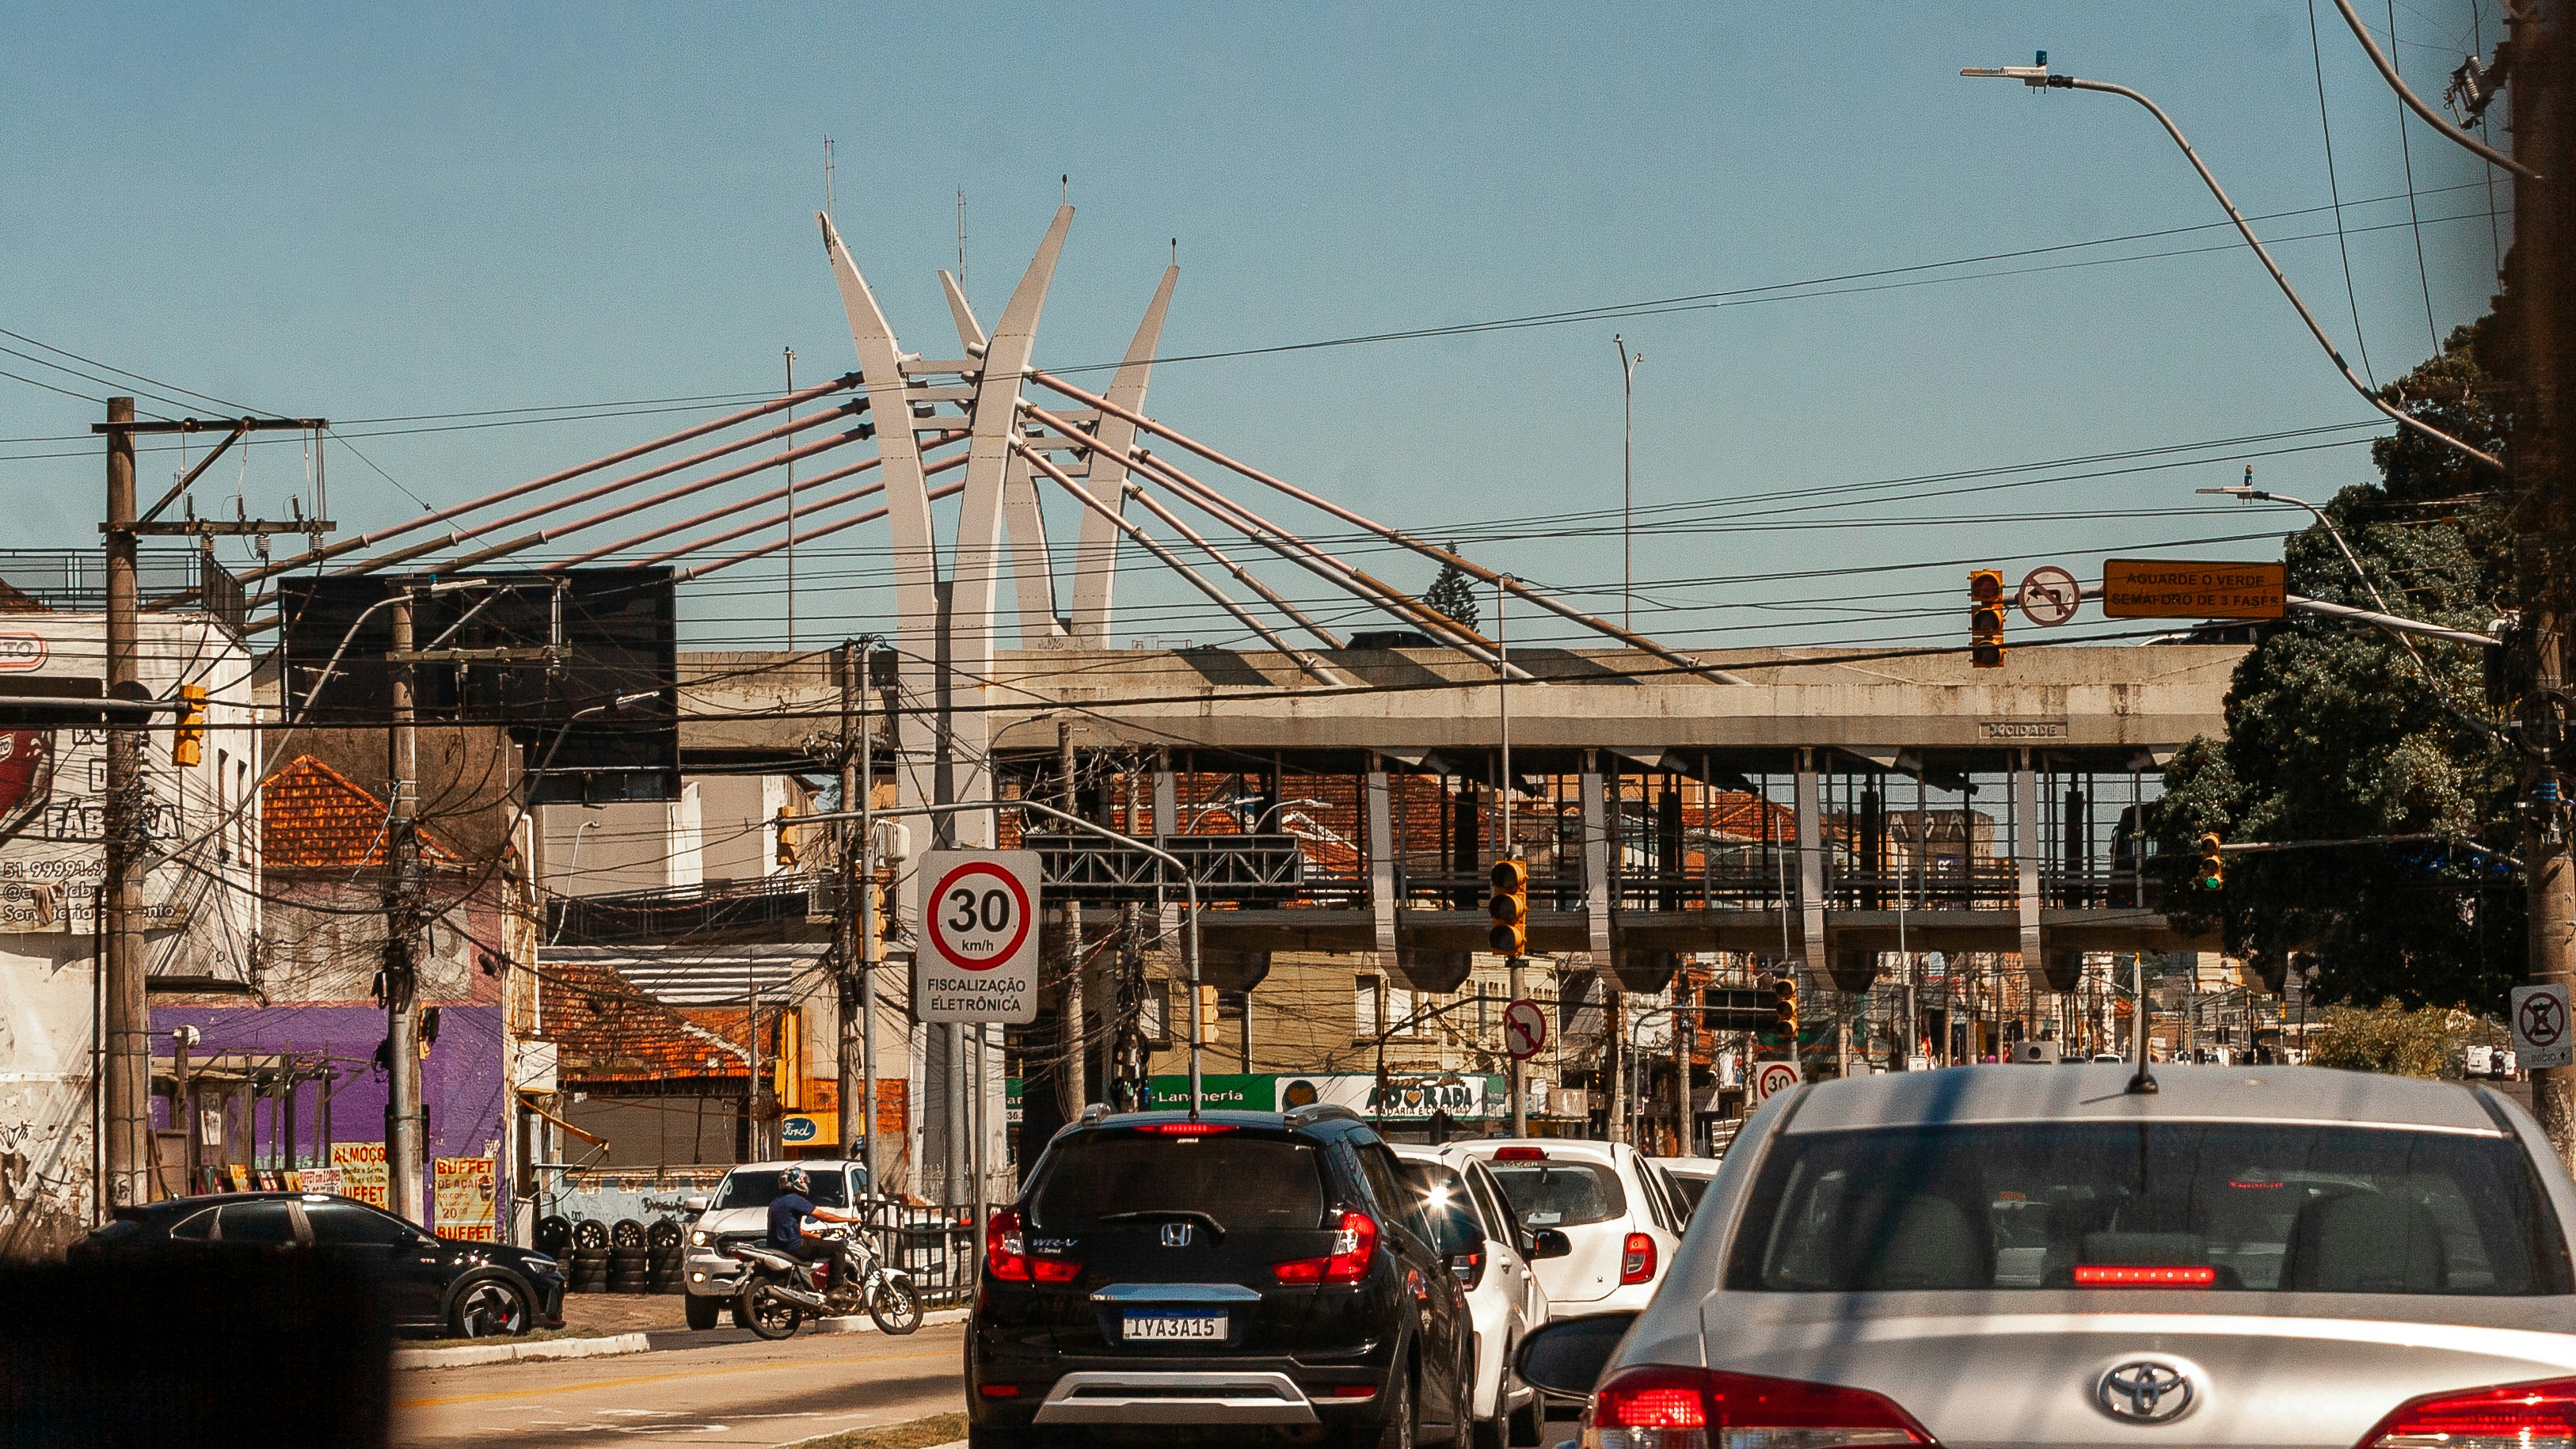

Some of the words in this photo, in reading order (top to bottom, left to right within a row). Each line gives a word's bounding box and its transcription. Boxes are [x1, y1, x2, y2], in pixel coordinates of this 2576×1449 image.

[2126, 572, 2197, 585] AGUARDE
[2202, 574, 2213, 585] O
[2217, 576, 2266, 587] VERDE
[2197, 595, 2216, 606] DE
[2221, 595, 2228, 606] 3
[2233, 595, 2279, 607] FASES
[3, 860, 24, 877] 51
[948, 888, 1010, 933] 30
[962, 940, 994, 952] km/h
[927, 977, 1026, 995] FISCALIZAÇÃO
[931, 996, 1022, 1012] ELETRÔNICA
[1768, 1075, 1790, 1093] 30
[782, 1122, 810, 1136] Ford
[333, 1147, 386, 1166] ALMOÇO
[437, 1160, 493, 1175] BUFFET
[438, 1179, 451, 1189] DE
[341, 1186, 386, 1202] UFFET
[437, 1226, 493, 1241] BUFFET
[1132, 1318, 1216, 1337] IYA3A15
